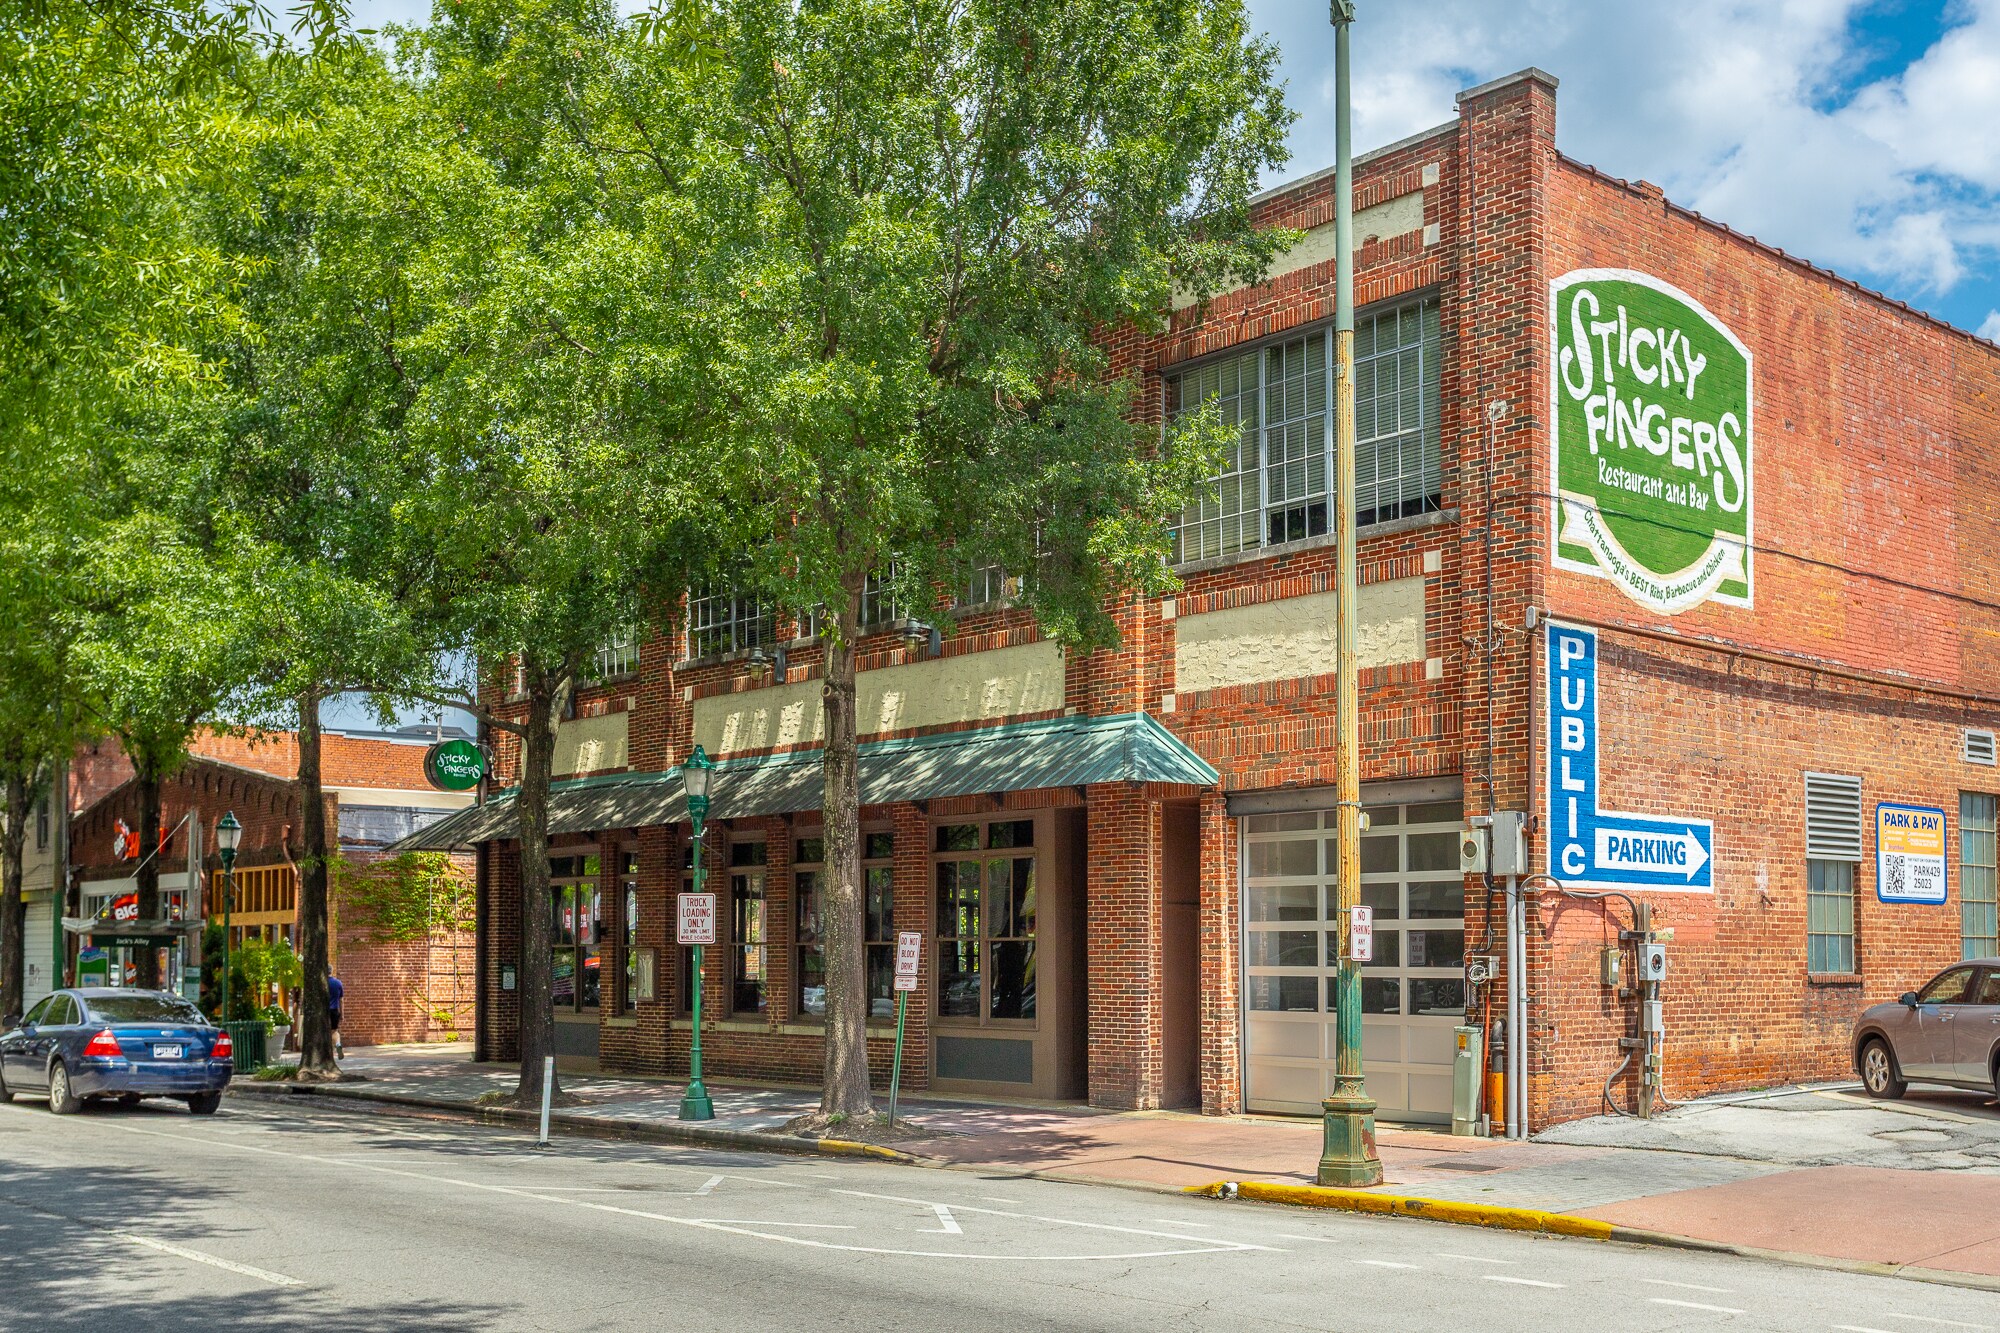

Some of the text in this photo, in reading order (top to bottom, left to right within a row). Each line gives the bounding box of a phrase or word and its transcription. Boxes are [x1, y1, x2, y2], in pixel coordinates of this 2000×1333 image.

[1584, 385, 1744, 513] FINGERS
[1598, 457, 1709, 512] Restaurant and Bar
[1584, 509, 1629, 581] Chattanooga's
[1629, 571, 1650, 594] BEST
[1665, 580, 1698, 599] Barbecue
[1697, 572, 1708, 586] and
[1706, 548, 1726, 577] Chicken
[437, 753, 471, 767] STICKY
[1559, 635, 1586, 876] PUBLIC
[443, 764, 481, 779] FINGERS
[1884, 813, 1939, 830] PARK & PAY
[1608, 836, 1687, 866] PARKING
[1914, 878, 1932, 889] 25023
[686, 898, 707, 907] TRUCK
[115, 904, 138, 920] BIG
[683, 908, 711, 917] LOADING
[1358, 911, 1366, 921] NO
[688, 919, 705, 928] ONLY
[1354, 924, 1370, 935] PARKING
[134, 938, 150, 946] Alley
[901, 937, 919, 946] DO NOT
[1358, 938, 1366, 946] ANY
[901, 949, 915, 958] BLOCK
[900, 962, 914, 971] DRIVE
